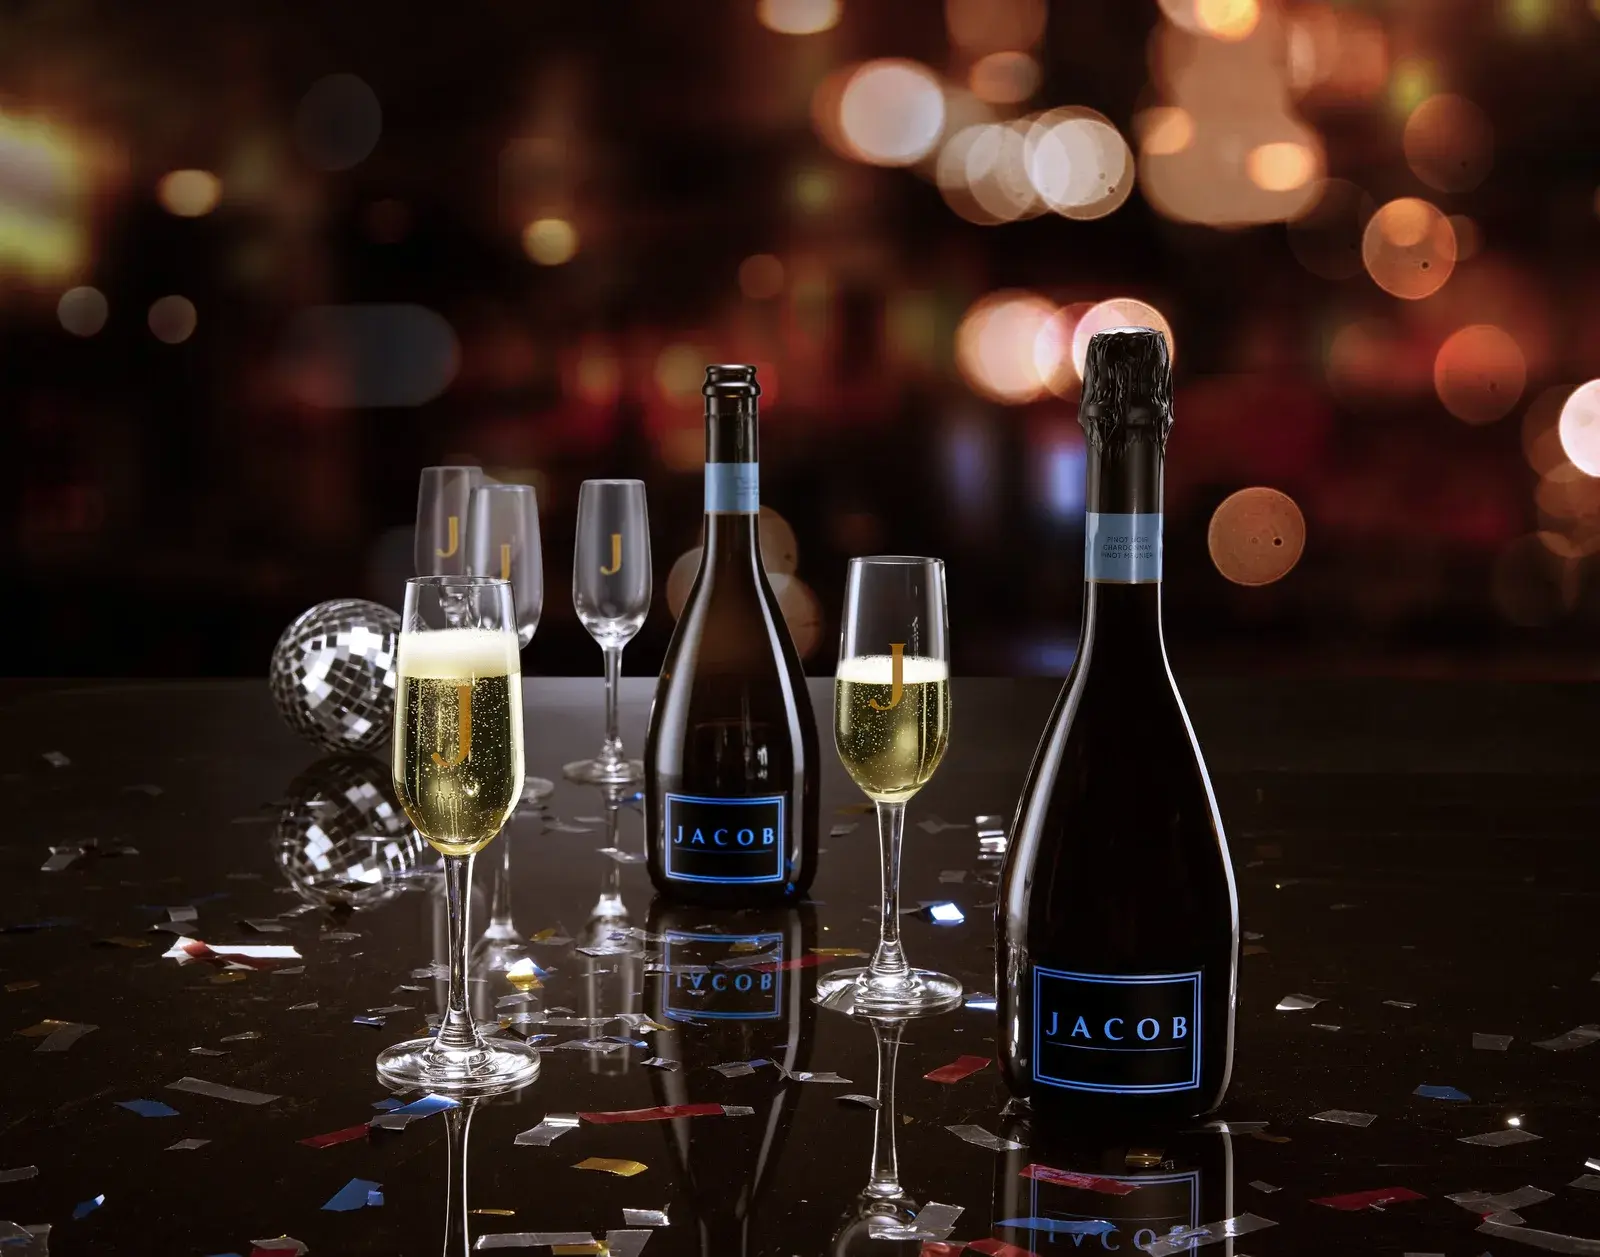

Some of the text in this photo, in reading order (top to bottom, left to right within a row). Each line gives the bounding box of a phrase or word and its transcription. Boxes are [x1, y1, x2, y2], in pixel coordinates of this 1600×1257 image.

[435, 516, 459, 557] J
[600, 533, 622, 576] J
[869, 642, 907, 711] J
[431, 684, 472, 768] J
[674, 825, 774, 845] JACOB
[1046, 1011, 1187, 1041] JACOB
